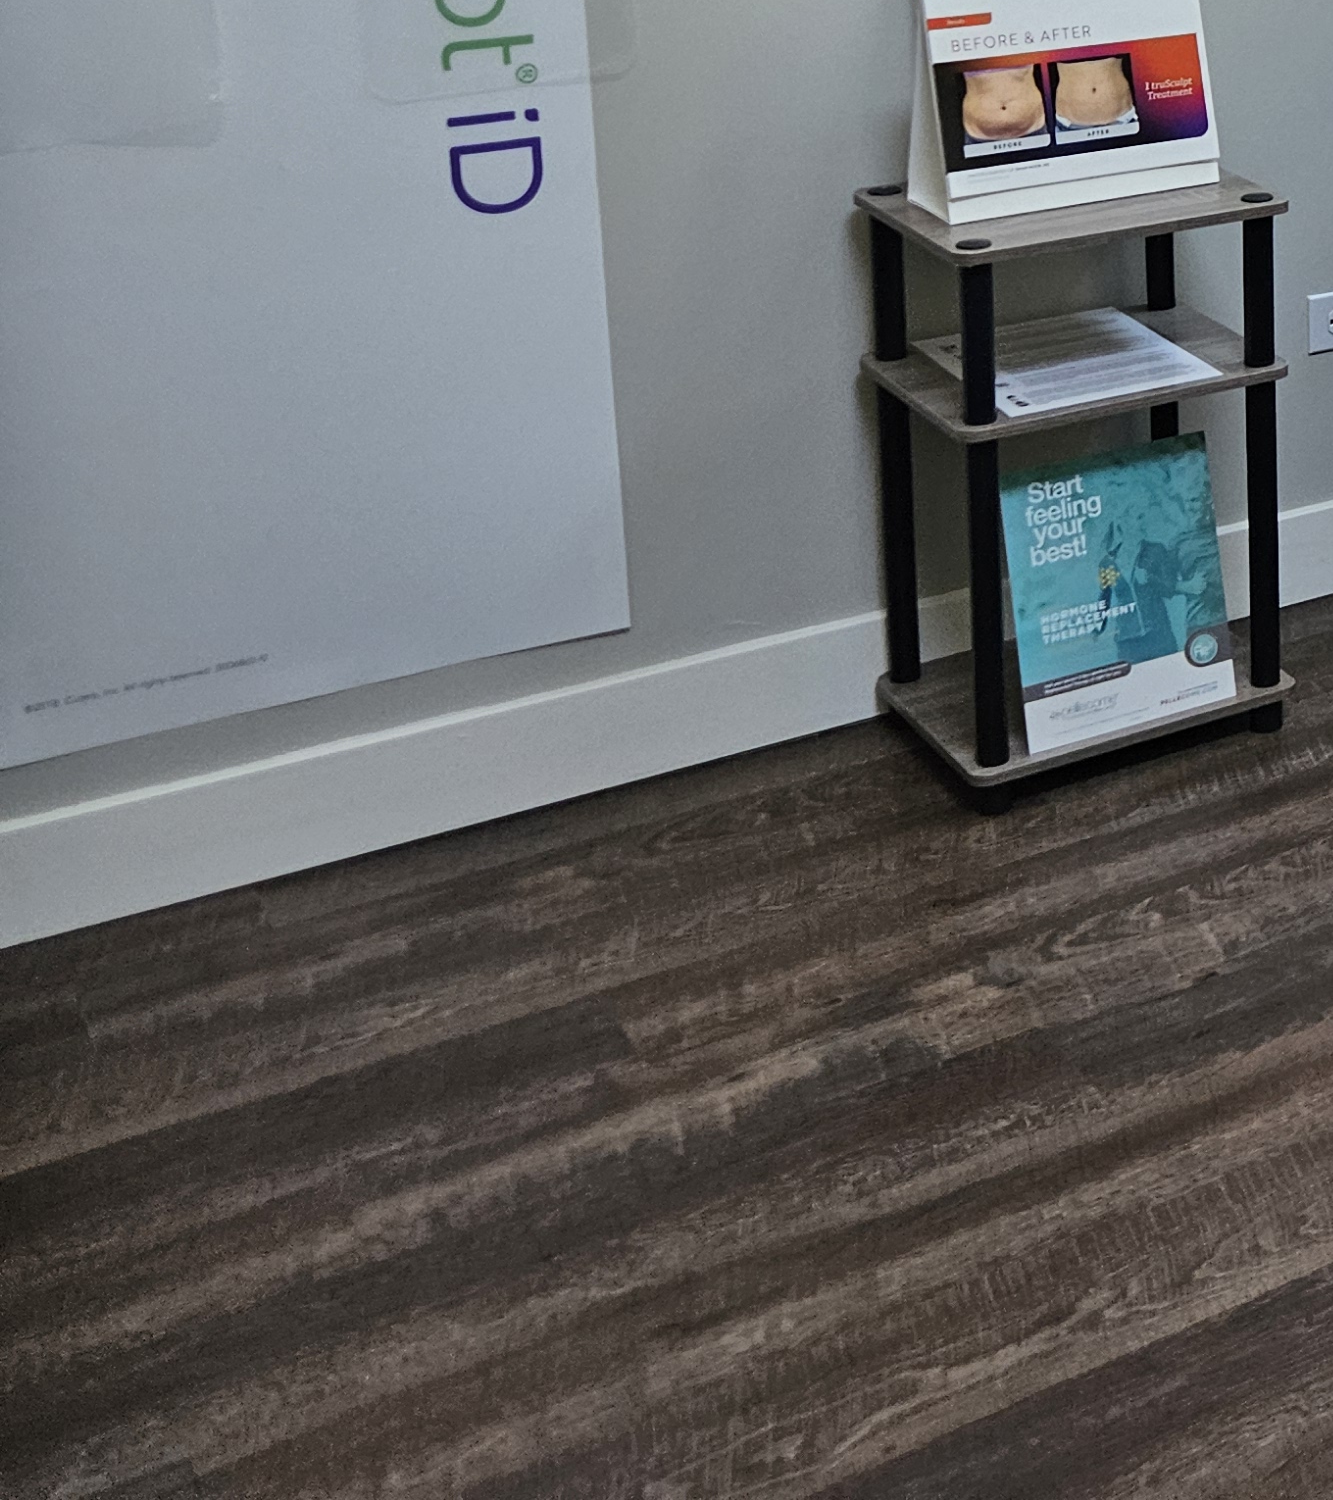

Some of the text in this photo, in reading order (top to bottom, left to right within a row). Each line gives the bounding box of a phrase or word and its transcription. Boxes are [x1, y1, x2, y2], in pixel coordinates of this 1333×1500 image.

[951, 25, 1091, 52] BEFORE & AFTER
[1147, 88, 1192, 100] Treatment
[1151, 77, 1192, 90] truSculpt
[993, 141, 1022, 150] BEFORE
[446, 108, 544, 216] iD
[1028, 475, 1084, 503] Start
[1025, 495, 1101, 527] feeling
[1033, 516, 1087, 548] your
[1030, 534, 1088, 567] best!
[1040, 600, 1107, 623] HORMONE
[1041, 602, 1137, 634] REPLACEMENT
[1042, 622, 1103, 644] THERAPY
